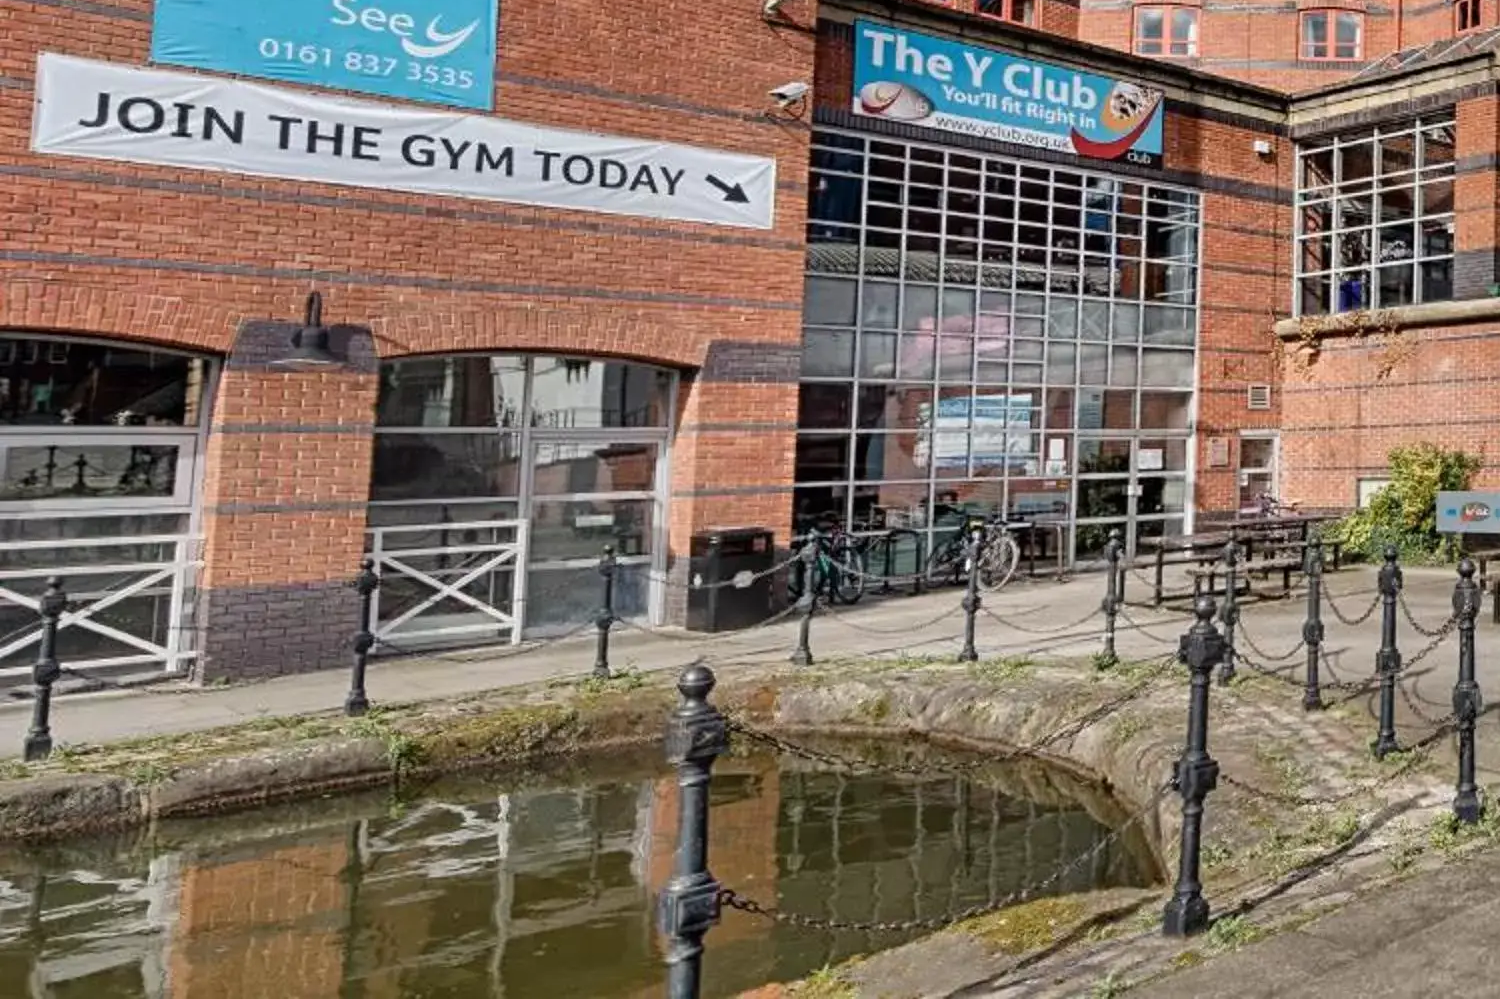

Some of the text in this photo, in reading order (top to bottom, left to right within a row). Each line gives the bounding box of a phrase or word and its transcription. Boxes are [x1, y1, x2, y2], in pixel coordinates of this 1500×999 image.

[259, 37, 473, 90] 0161 837 3535
[863, 29, 1097, 109] The Y Club
[935, 115, 1071, 149] www.yclub.org.uk
[942, 83, 998, 110] You'll
[1001, 96, 1022, 116] fit
[1026, 101, 1076, 128] Right
[1078, 110, 1097, 130] in
[79, 92, 686, 197] JOIN THE GYM TODAY
